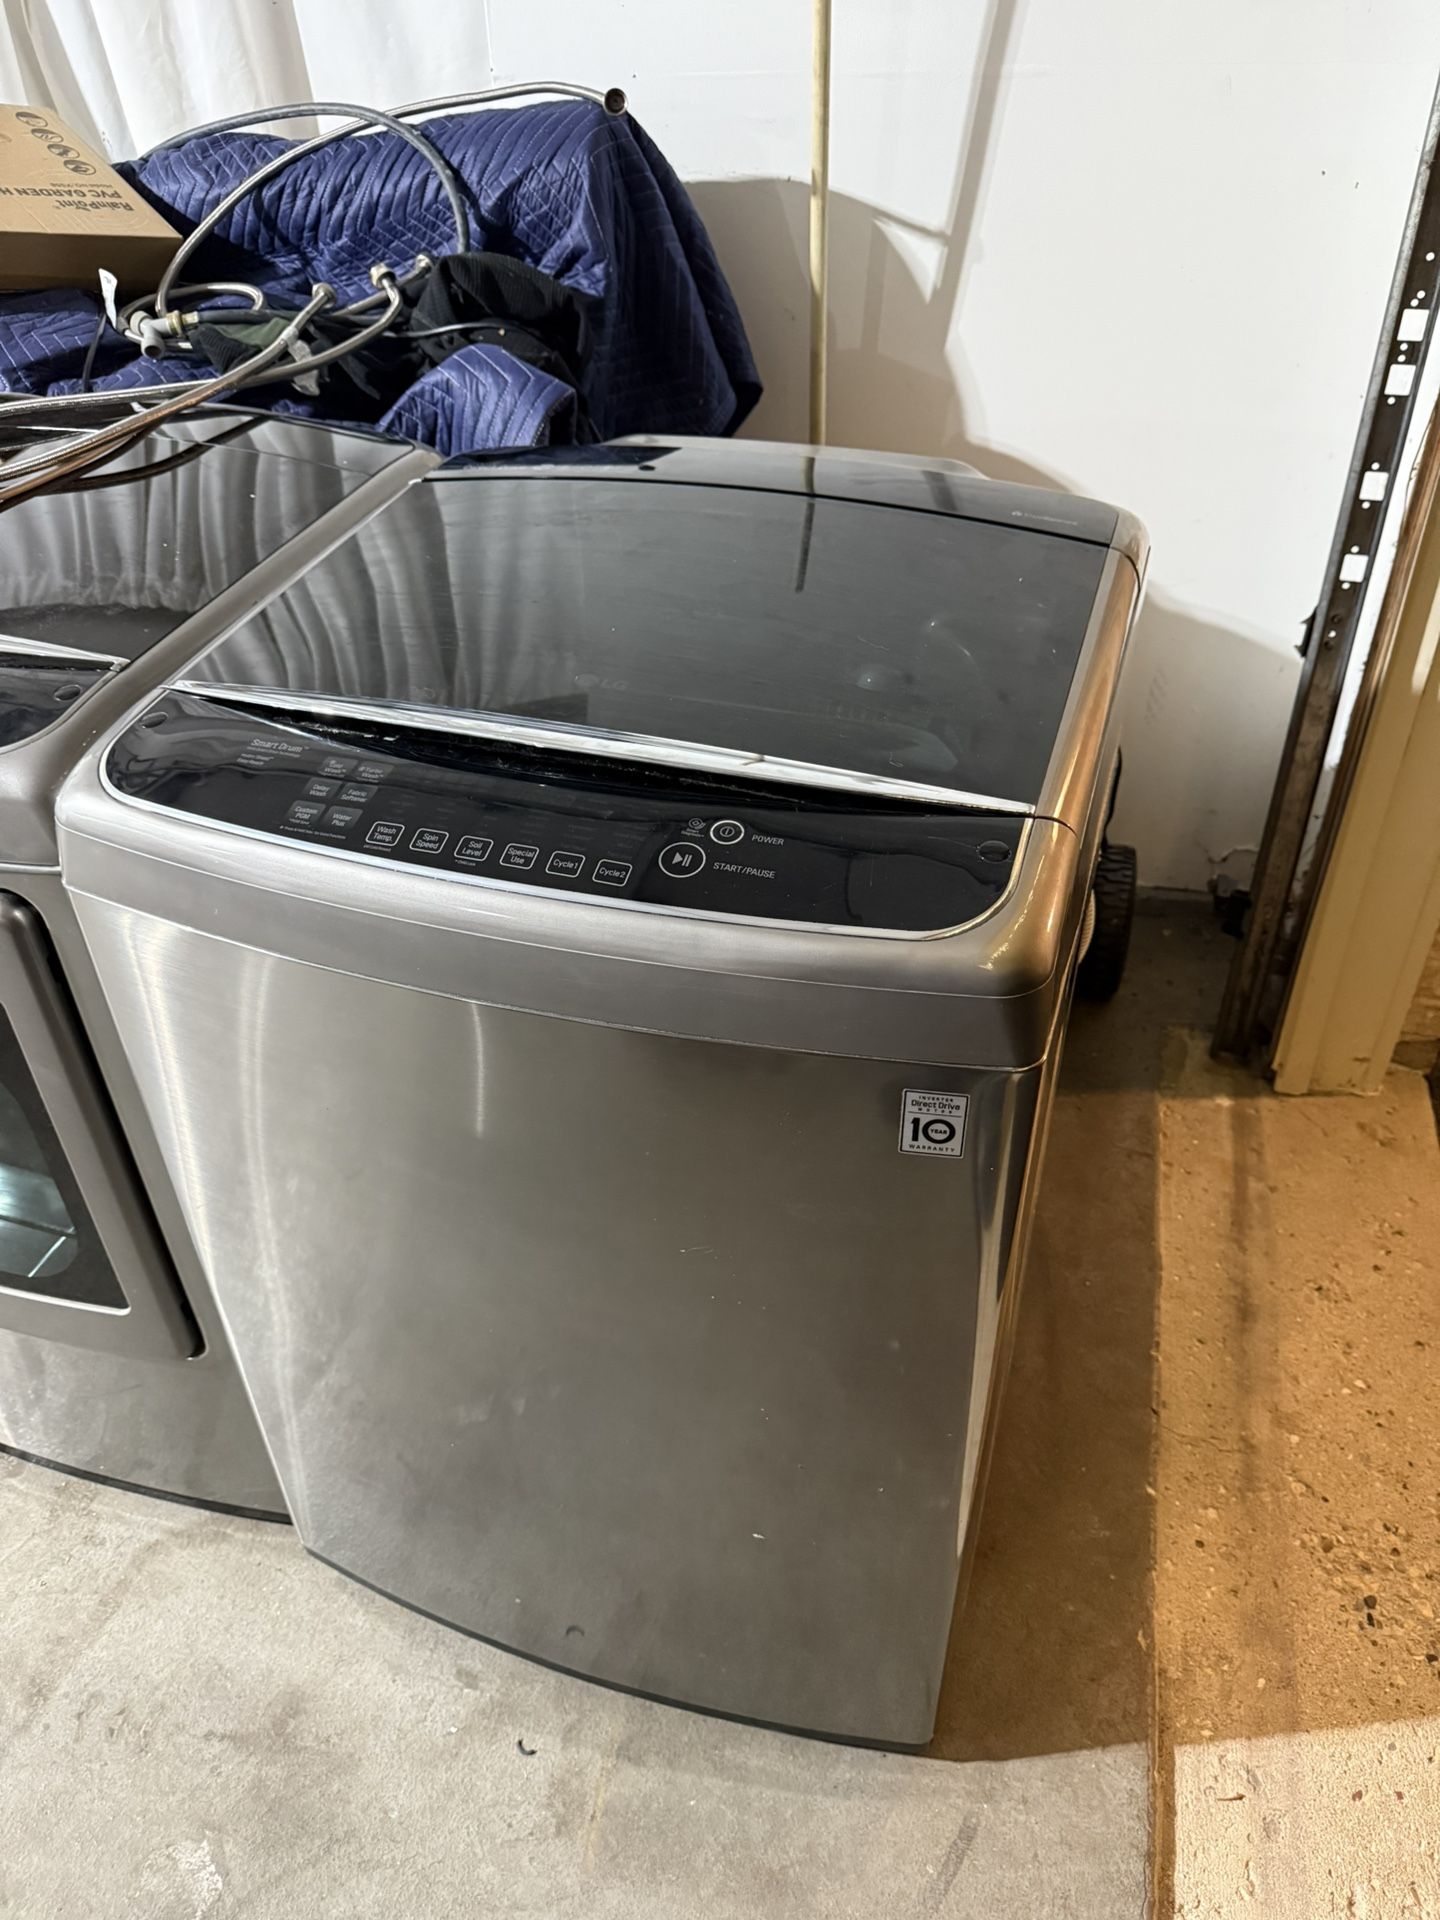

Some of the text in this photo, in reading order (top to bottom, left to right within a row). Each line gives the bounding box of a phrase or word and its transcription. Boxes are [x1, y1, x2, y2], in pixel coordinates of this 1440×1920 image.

[14, 188, 86, 198] GARDEN
[88, 189, 122, 199] PVC
[56, 199, 134, 212] RainPoint
[252, 738, 278, 749] Smart
[376, 825, 397, 835] Wash
[373, 832, 393, 842] Temp.
[422, 832, 439, 843] Spin
[751, 834, 785, 846] POWER
[415, 839, 439, 850] Speed
[468, 840, 483, 850] Soil
[462, 847, 483, 858] Level
[507, 846, 536, 859] Special
[510, 856, 526, 865] Use
[713, 862, 776, 879] START/PAUSE
[911, 1099, 960, 1111] Direct Drive
[911, 1117, 955, 1144] 10
[909, 1144, 955, 1152] WARRANTY
